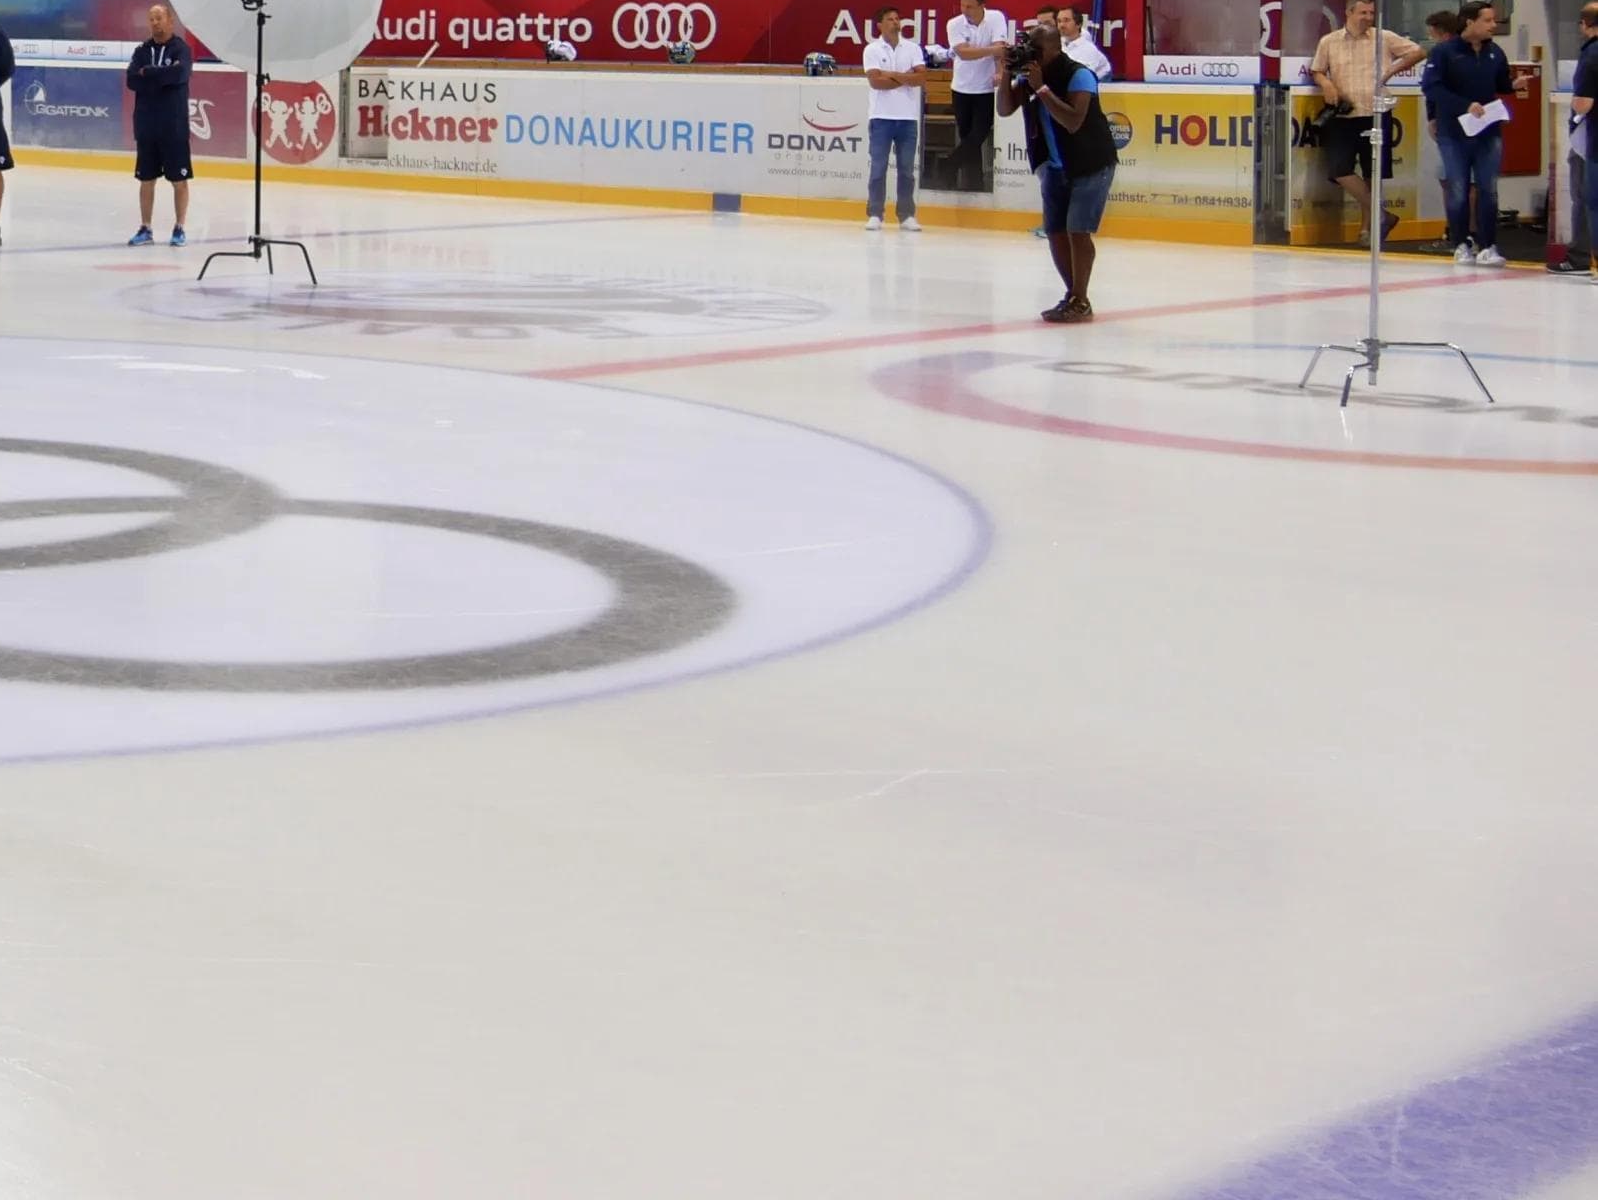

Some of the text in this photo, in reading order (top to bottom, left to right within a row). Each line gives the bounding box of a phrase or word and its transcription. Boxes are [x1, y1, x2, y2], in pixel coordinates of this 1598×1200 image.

[373, 9, 593, 49] udi quattro
[1156, 62, 1197, 78] Audi
[358, 79, 497, 103] BACKHAUS
[357, 105, 498, 143] Hckner
[505, 113, 755, 155] DONAUKURIER
[767, 133, 863, 154] DONAT
